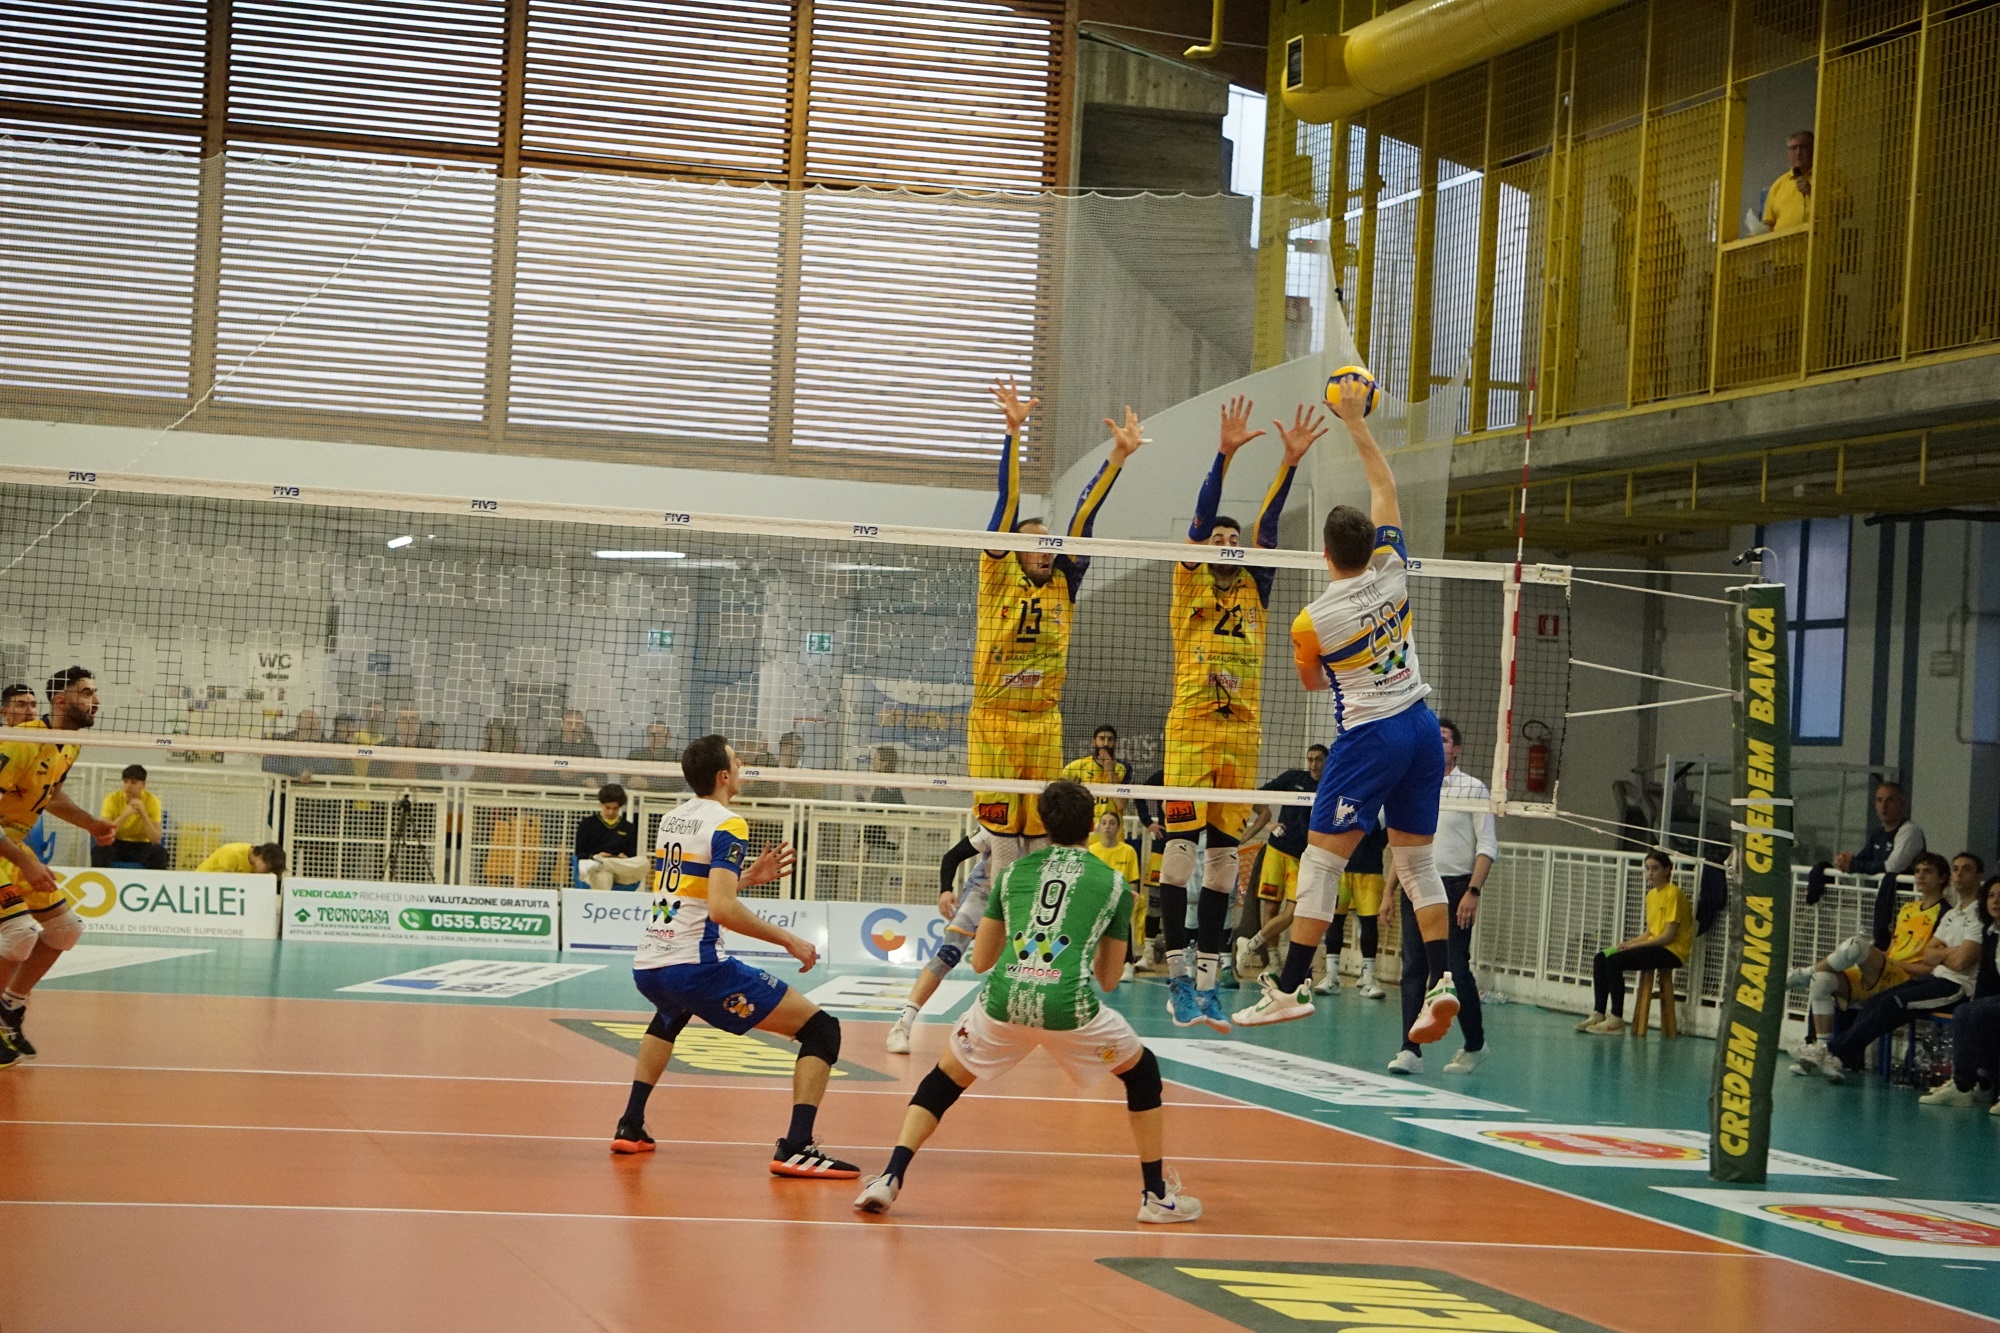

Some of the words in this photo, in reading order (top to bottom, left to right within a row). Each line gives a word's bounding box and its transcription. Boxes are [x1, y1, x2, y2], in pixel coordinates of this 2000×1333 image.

[68, 472, 96, 482] FIVB
[273, 486, 300, 496] FIVB
[471, 500, 497, 510] FIVB
[664, 513, 690, 523] FIVB
[853, 526, 878, 535] FIVB
[1038, 538, 1063, 547] FIVB
[1220, 549, 1245, 558] FIVB
[1408, 561, 1422, 569] VB
[1017, 598, 1042, 634] 15
[1214, 602, 1246, 638] 22
[1359, 600, 1402, 658] 20
[258, 652, 291, 668] WC
[1747, 607, 1776, 725] BANCA
[1745, 738, 1775, 874] CREDEM
[659, 841, 682, 893] 18
[292, 889, 322, 898] VENDI
[324, 890, 358, 900] CASA?
[360, 892, 402, 901] RICHIEDI
[404, 893, 426, 903] UNA
[428, 895, 498, 906] VALUTAZIONE
[500, 898, 550, 908] GRATUITA
[1036, 879, 1067, 926] 9
[317, 907, 390, 925] TECNOCASA
[583, 903, 650, 923] Spectr
[88, 923, 125, 932] STATALE
[127, 925, 137, 933] DI
[138, 926, 192, 935] ISTRUZIONE
[194, 928, 244, 937] SUPERIORE
[431, 913, 543, 932] 0535.652477
[1735, 895, 1774, 1013] BANCA
[1006, 963, 1061, 979] wimore
[1719, 1020, 1759, 1157] CREDEM
